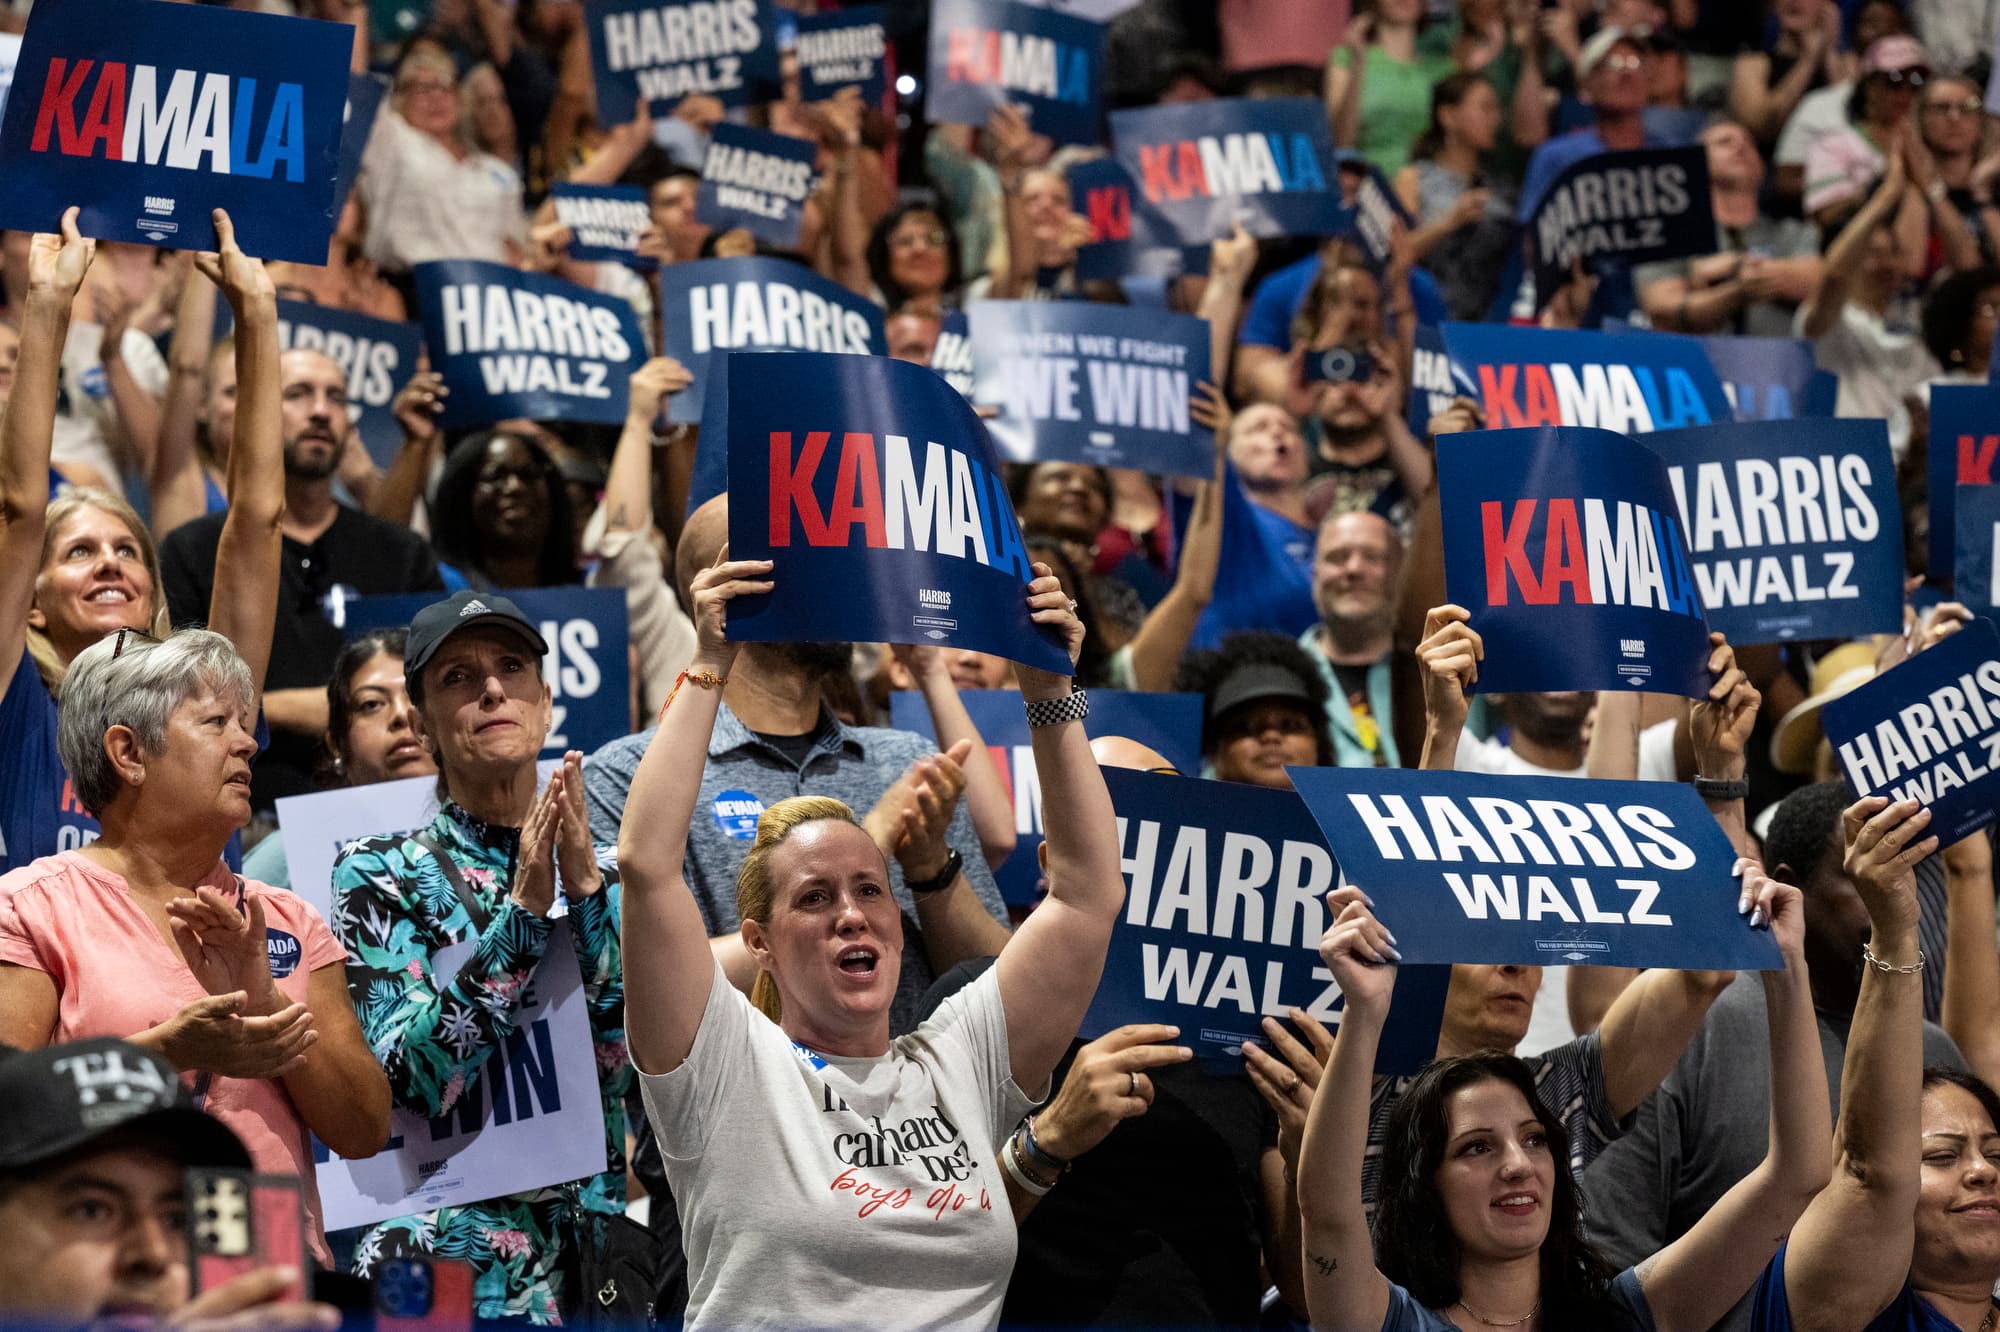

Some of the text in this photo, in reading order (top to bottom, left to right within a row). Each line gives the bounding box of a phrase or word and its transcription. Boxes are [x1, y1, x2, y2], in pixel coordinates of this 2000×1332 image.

[603, 0, 761, 72] HARRIS
[637, 56, 744, 102] WALZ
[30, 57, 306, 183] KAMALA
[704, 142, 811, 200] HARRIS
[1139, 132, 1327, 203] KAMALA
[144, 196, 175, 211] HARRIS
[441, 284, 632, 362] HARRIS
[690, 282, 872, 356] HARRIS
[480, 355, 611, 398] WALZ
[1086, 360, 1192, 434] WIN
[1478, 363, 1712, 432] KAMALA
[919, 588, 952, 605] HARRIS
[1694, 552, 1860, 609] WALZ
[1620, 639, 1646, 652] HARRIS
[1838, 660, 2000, 798] HARRIS
[1890, 731, 2000, 806] WALZ
[1346, 793, 1697, 870] HARRIS
[1116, 817, 1347, 951] HARR
[1443, 872, 1673, 926] WALZ
[1142, 943, 1345, 1024] WALZ
[830, 1168, 912, 1218] boys
[927, 1184, 973, 1221] do
